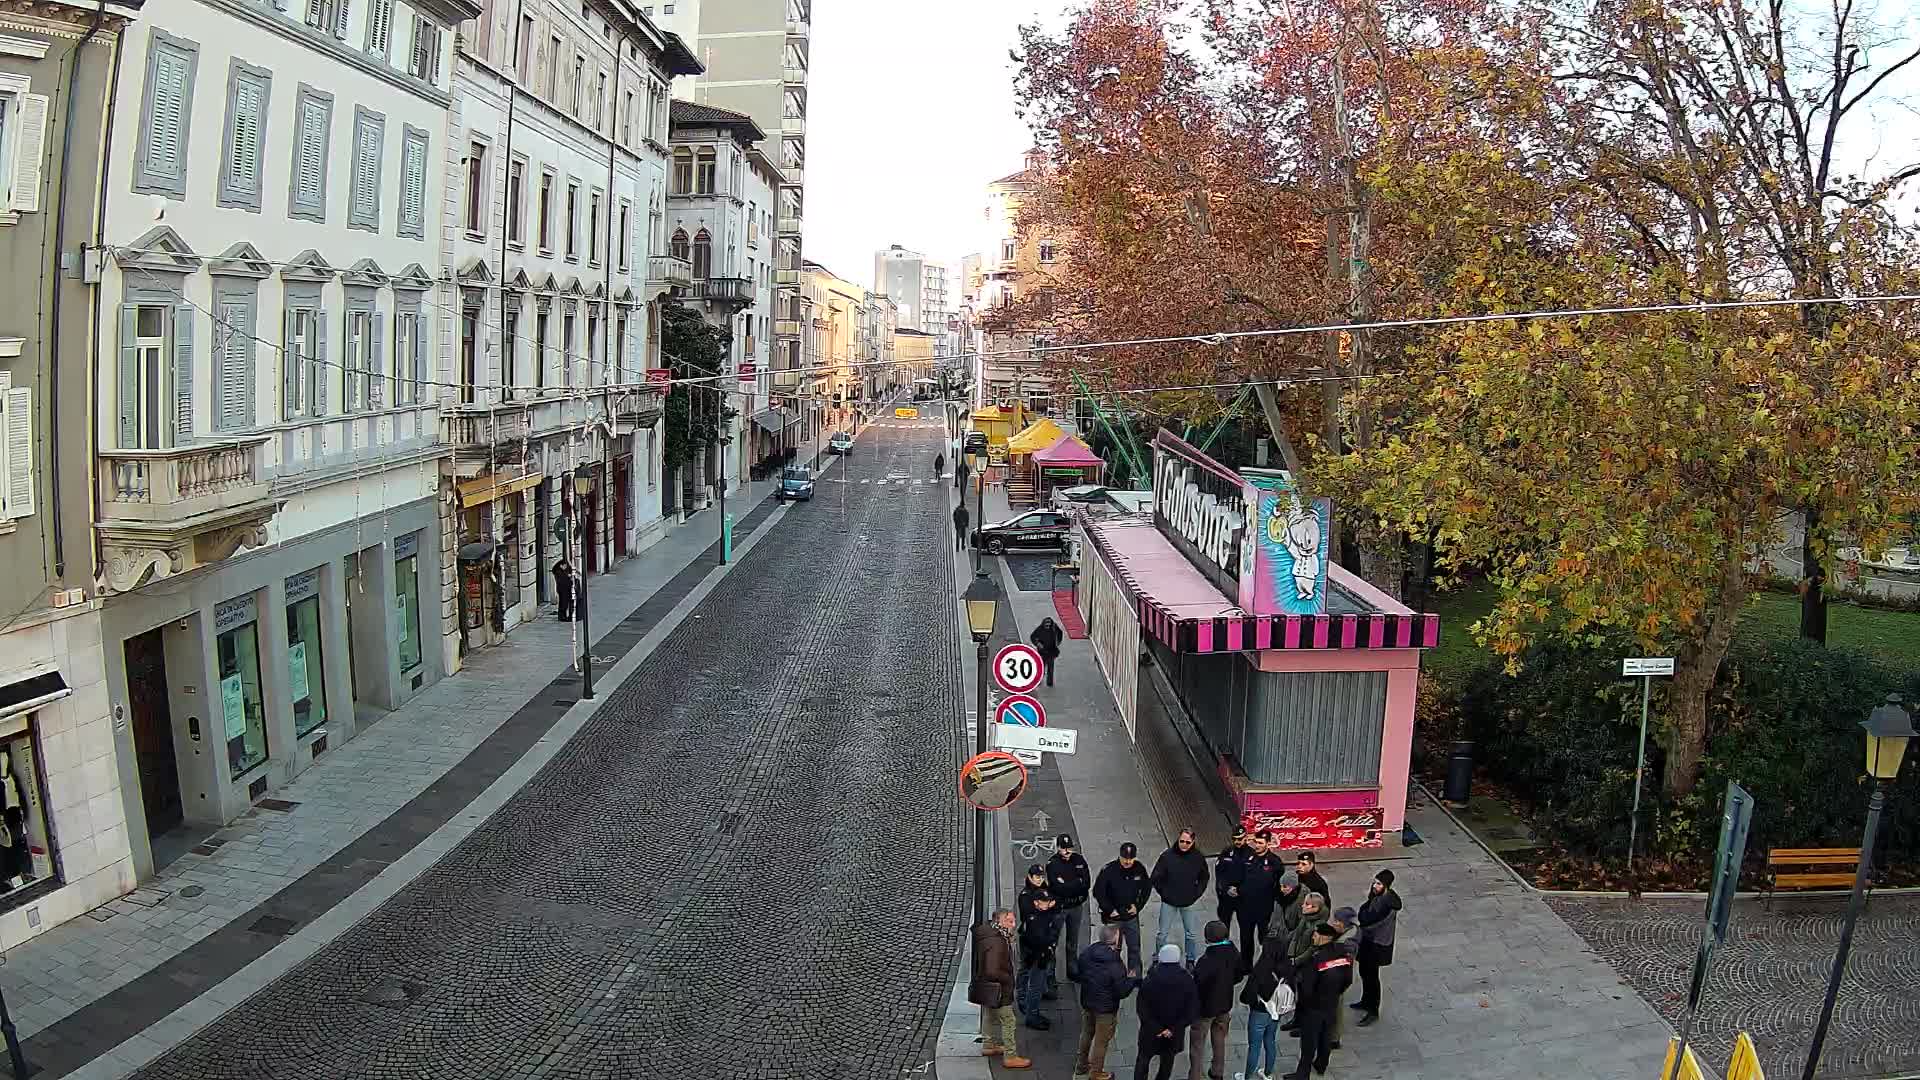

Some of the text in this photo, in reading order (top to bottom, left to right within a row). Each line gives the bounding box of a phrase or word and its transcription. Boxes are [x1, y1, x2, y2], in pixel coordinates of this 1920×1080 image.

[1163, 459, 1234, 569] Golosone
[1005, 658, 1033, 680] 30
[1038, 737, 1070, 748] Dante
